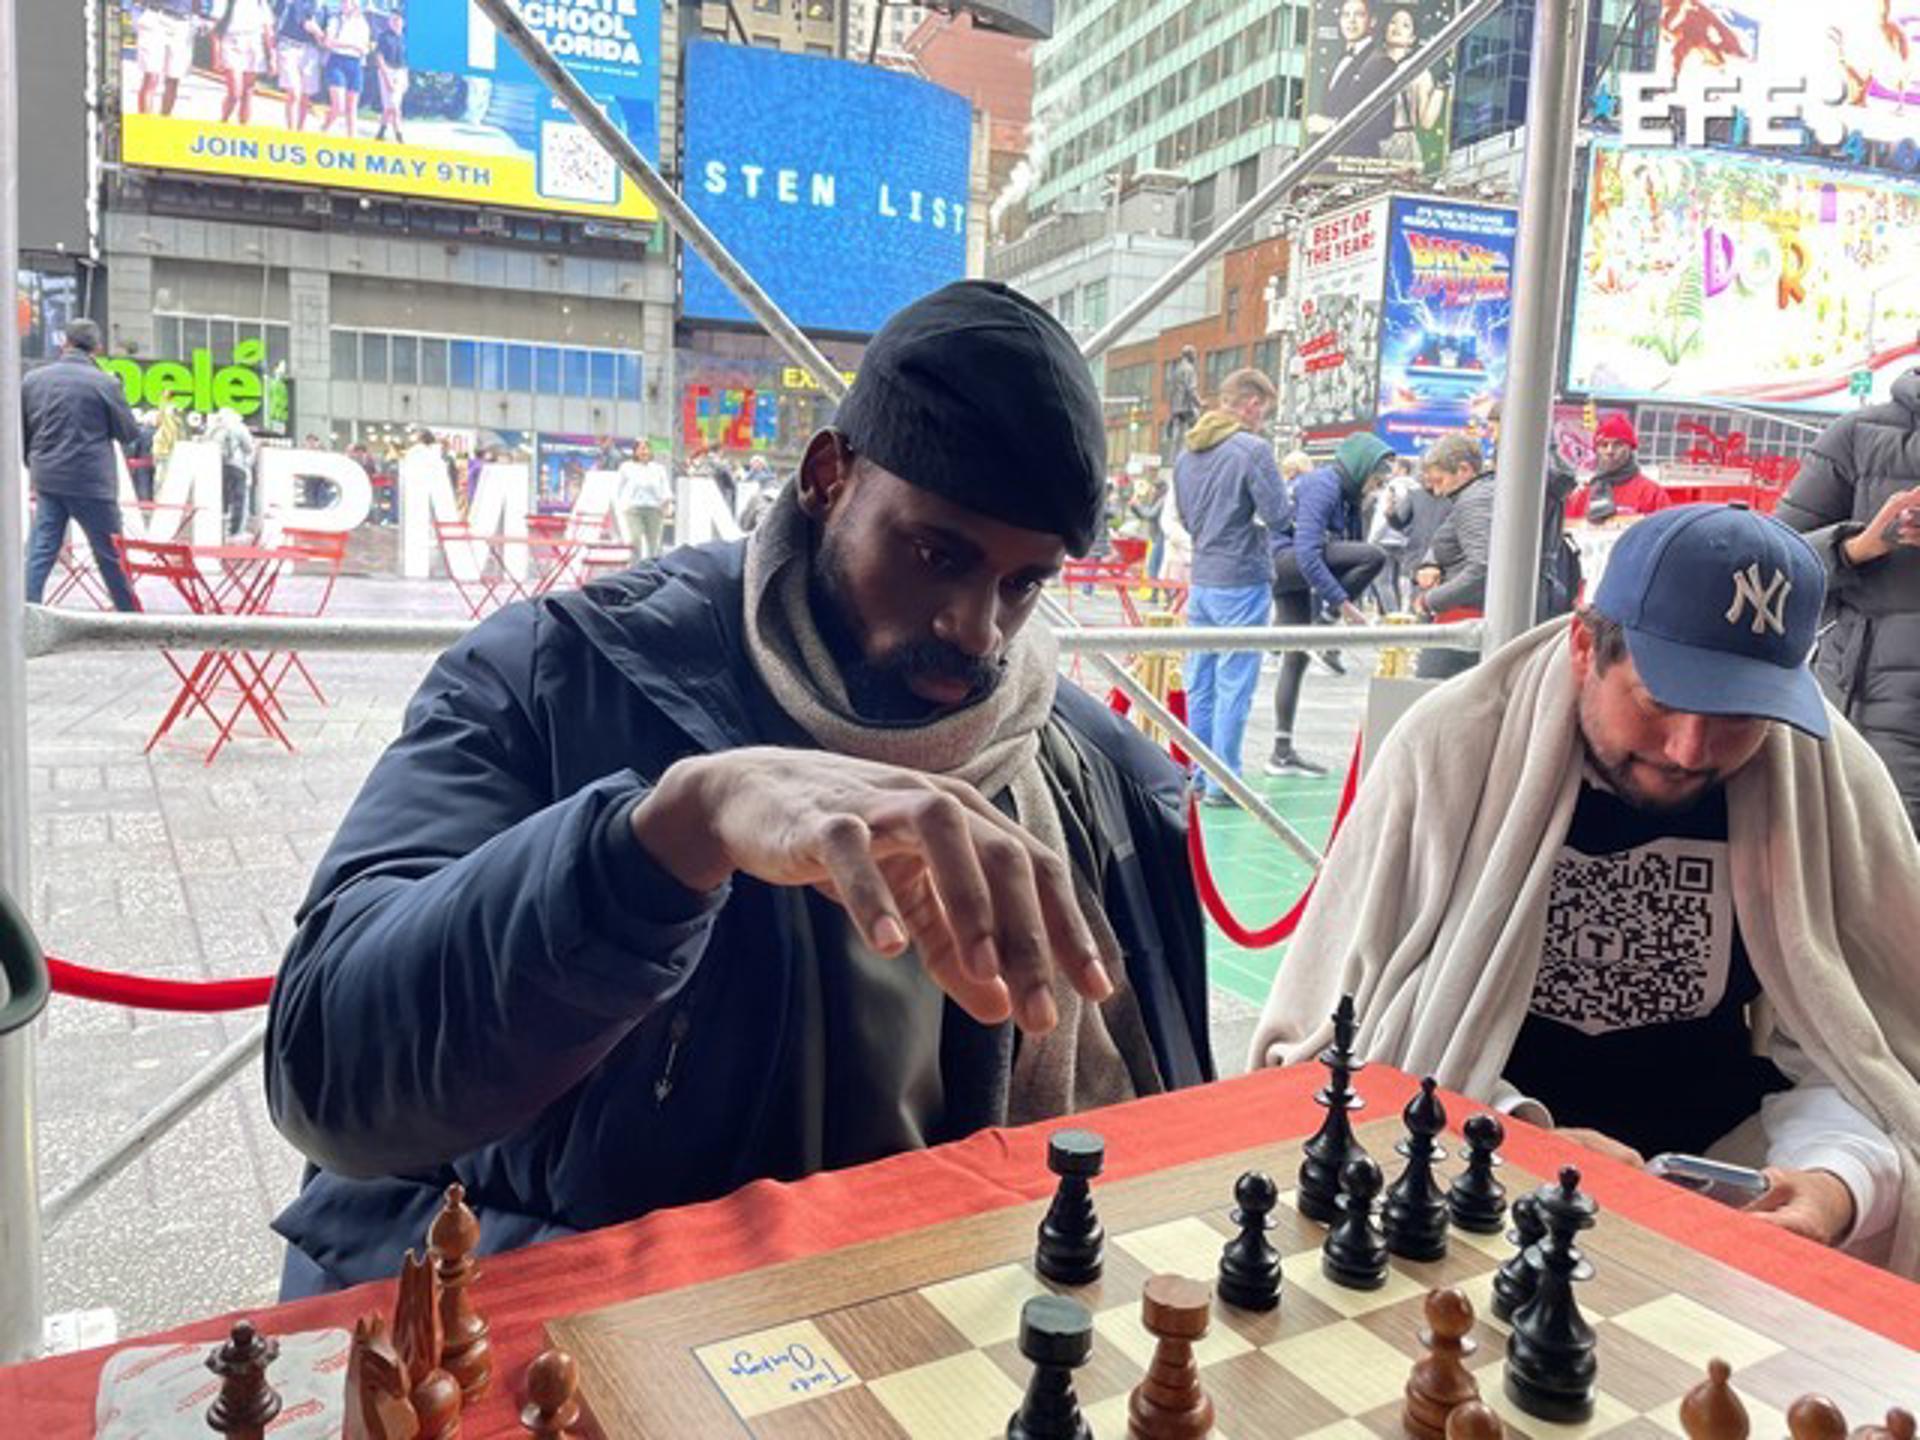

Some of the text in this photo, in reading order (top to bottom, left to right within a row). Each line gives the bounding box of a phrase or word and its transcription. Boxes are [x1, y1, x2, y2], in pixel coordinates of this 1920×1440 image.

[190, 135, 491, 185] JOIN US ON MAY 9TH
[704, 160, 965, 234] STEN LIST
[1313, 209, 1371, 246] BEST OF
[1306, 244, 1332, 267] THE
